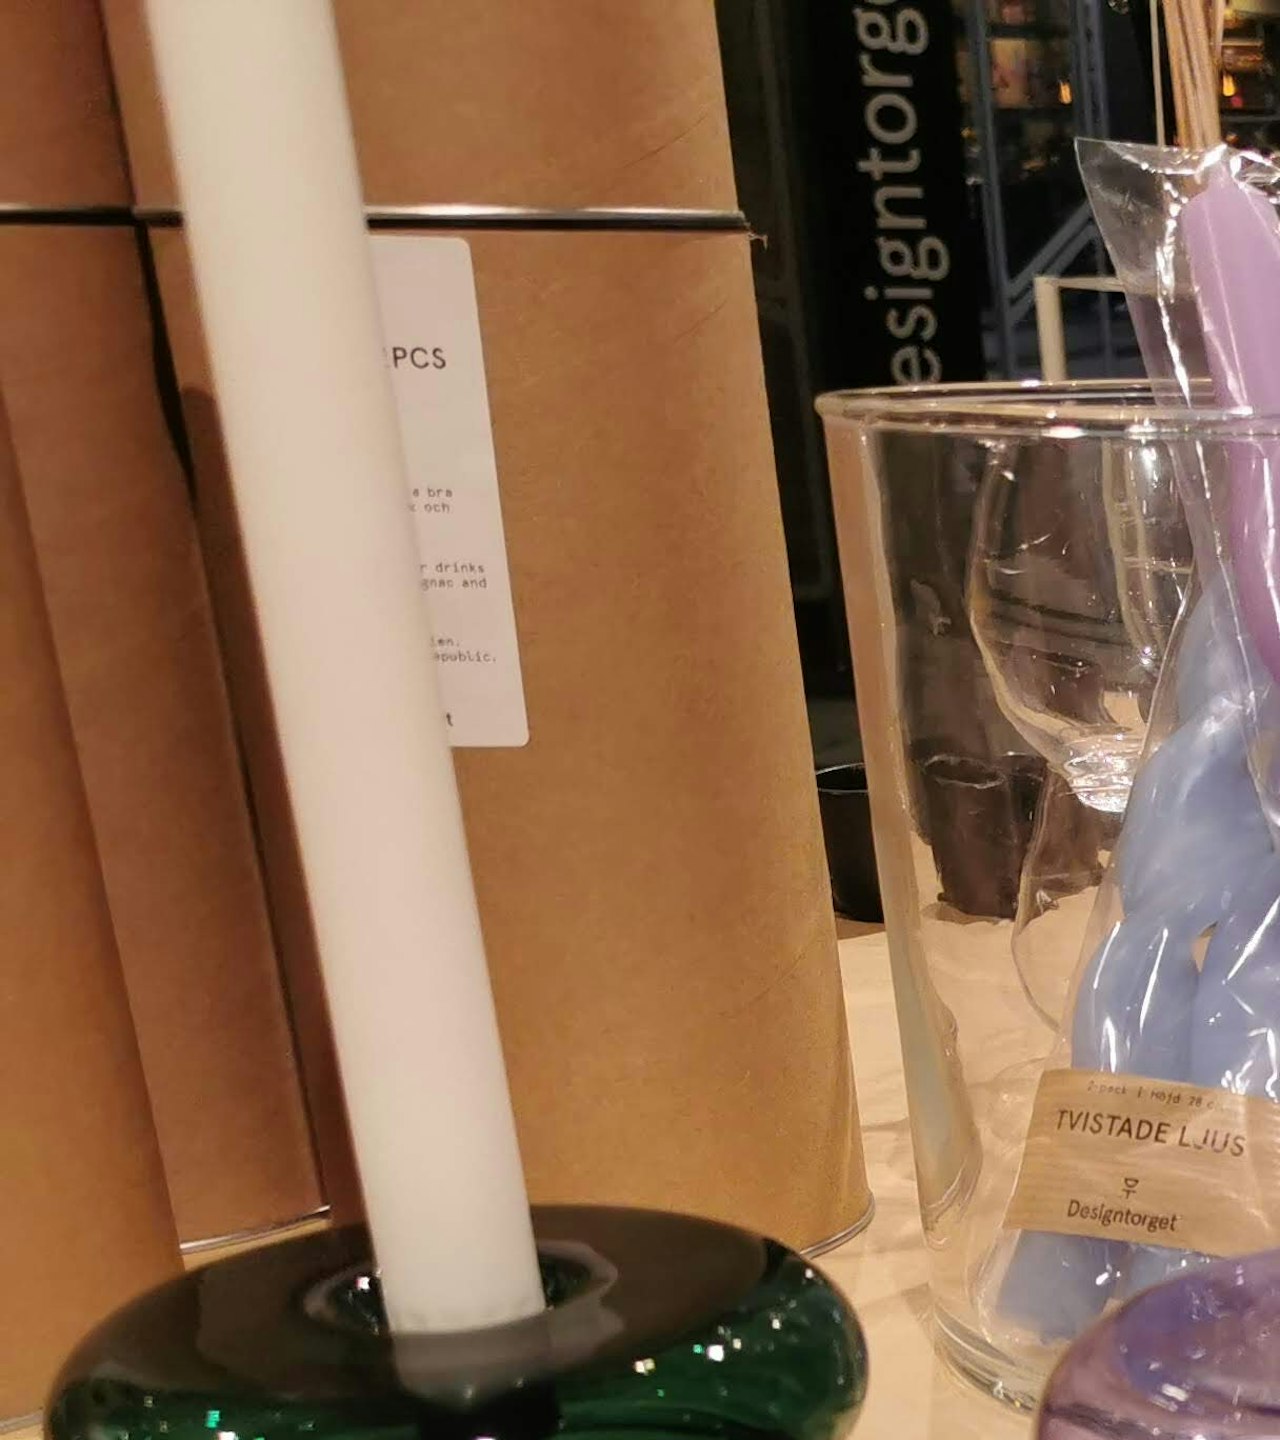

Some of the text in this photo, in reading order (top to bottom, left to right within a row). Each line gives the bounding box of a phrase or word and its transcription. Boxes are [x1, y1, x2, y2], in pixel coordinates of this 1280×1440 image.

[853, 0, 949, 383] esigntorg
[391, 345, 447, 370] PCS
[426, 486, 454, 499] bra
[423, 502, 451, 514] och
[435, 561, 486, 574] drinks
[420, 577, 488, 591] gnac and
[1057, 1109, 1246, 1157] TVISTADE LJUS
[1067, 1199, 1179, 1234] Designtorget
